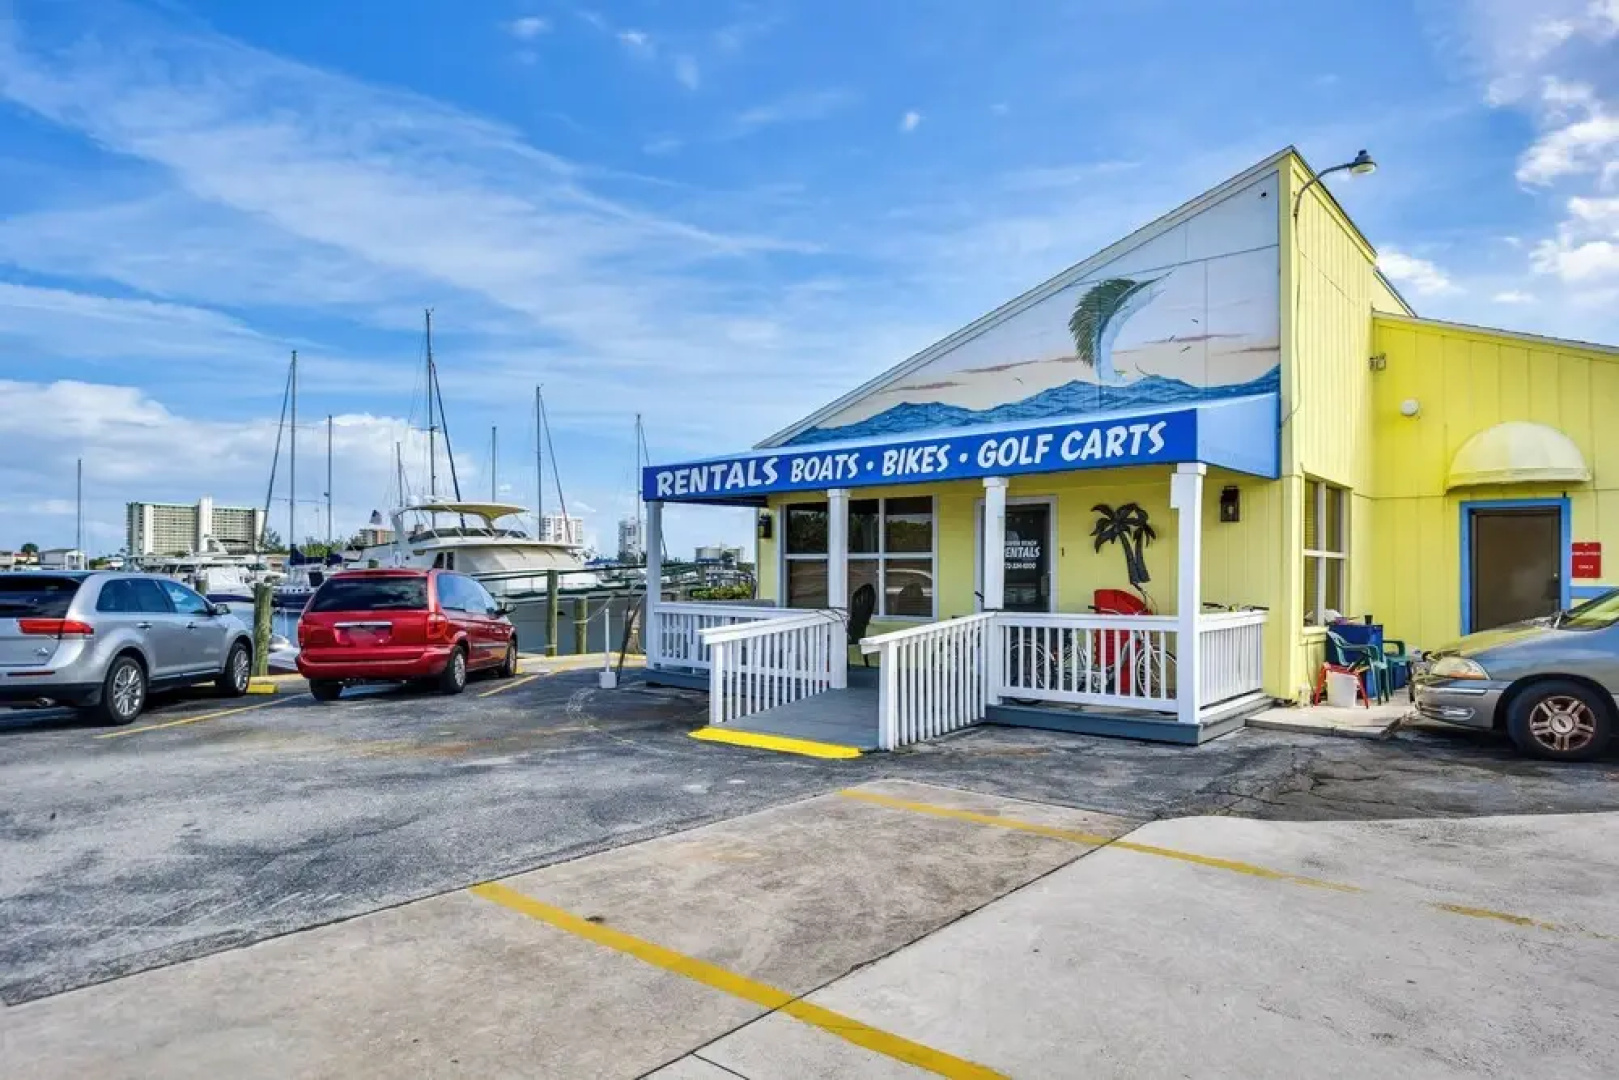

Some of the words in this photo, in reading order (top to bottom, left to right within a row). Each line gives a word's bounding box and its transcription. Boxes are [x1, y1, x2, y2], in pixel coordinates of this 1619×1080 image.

[656, 456, 779, 497] RENTALS
[790, 452, 860, 483] BOATS
[881, 444, 951, 478] BIKES
[977, 433, 1053, 469] GOLF
[1060, 420, 1168, 462] CARTS
[1004, 546, 1041, 558] ENTALS
